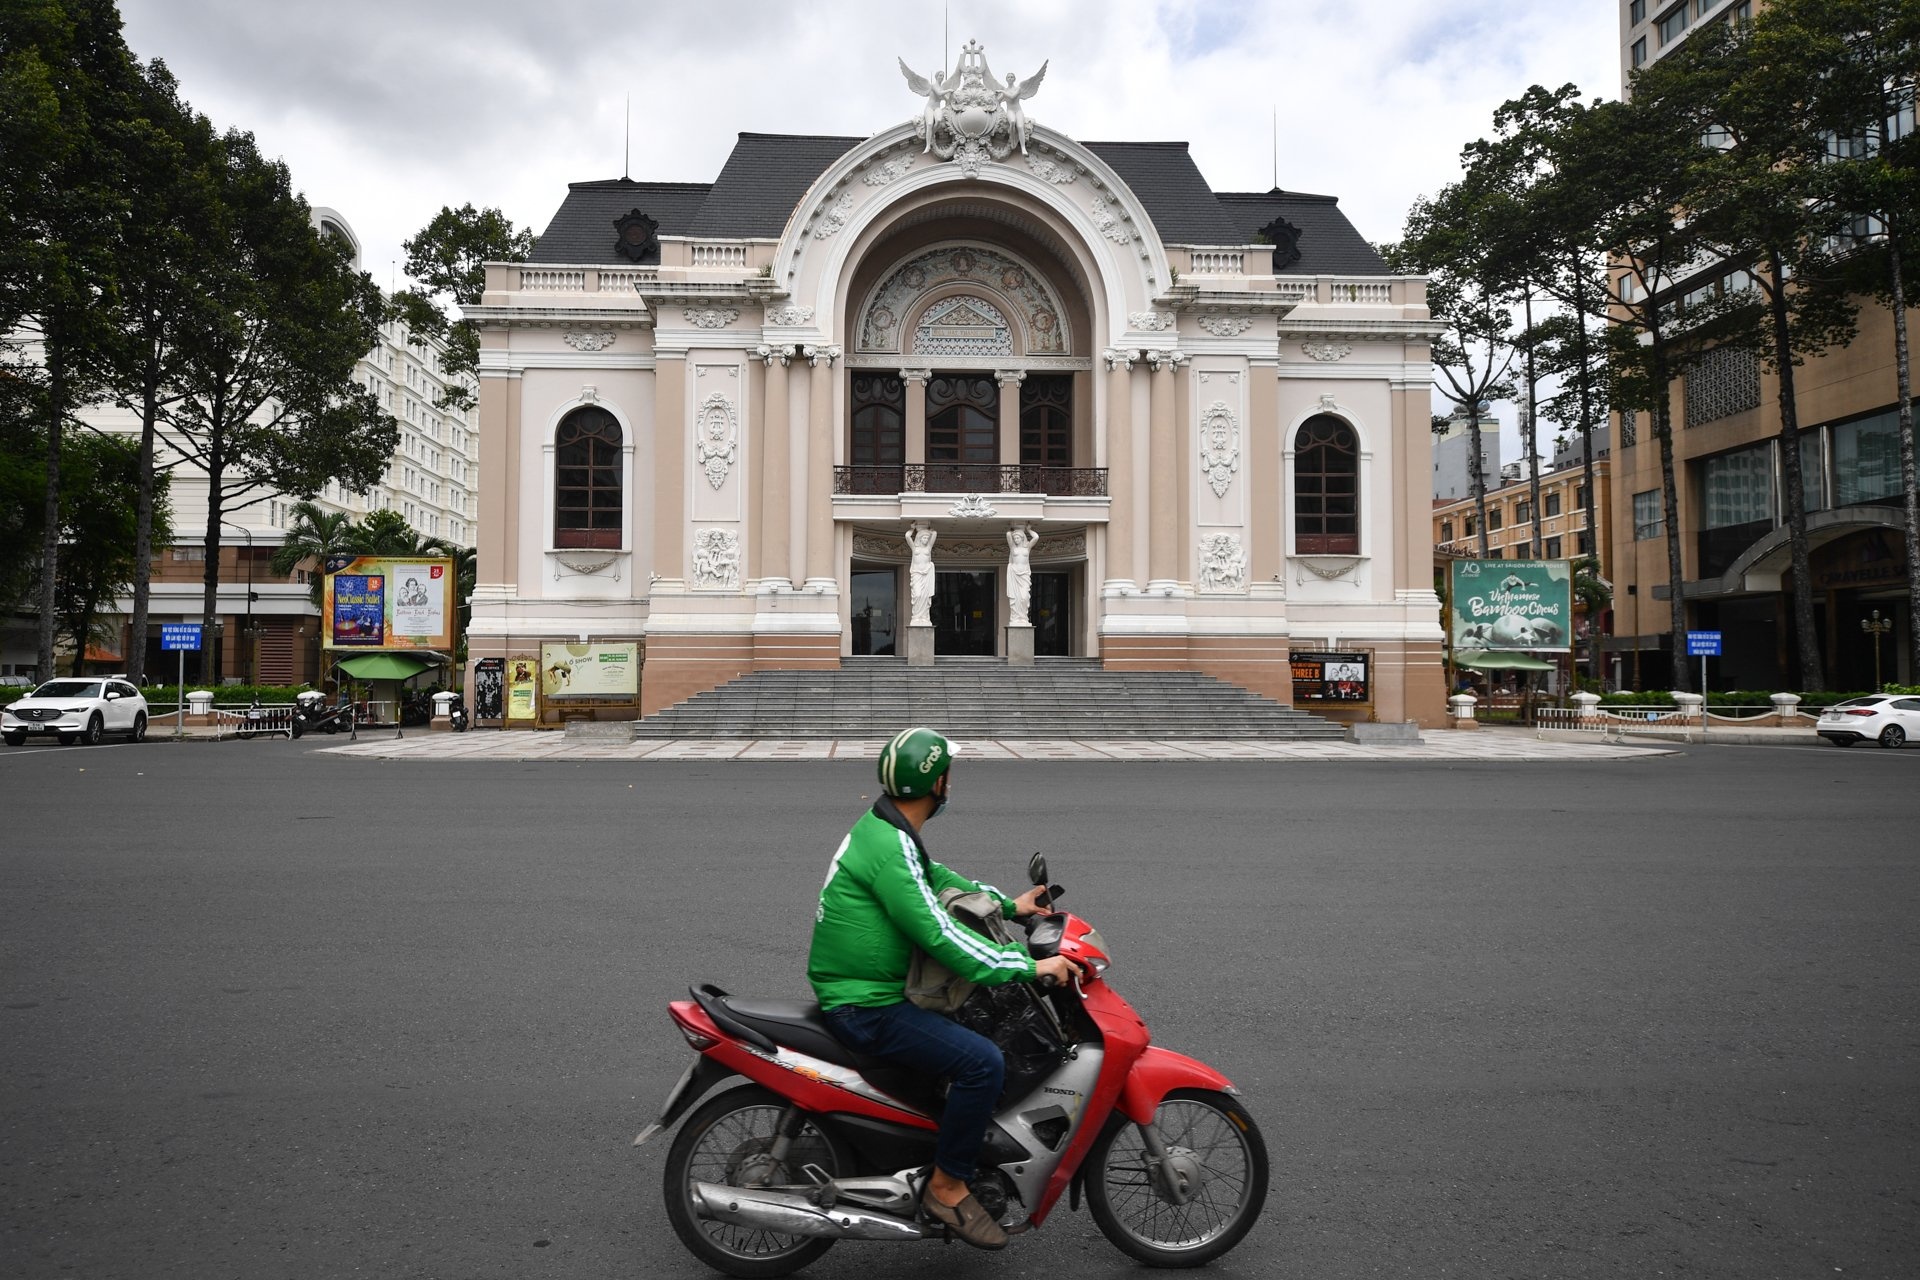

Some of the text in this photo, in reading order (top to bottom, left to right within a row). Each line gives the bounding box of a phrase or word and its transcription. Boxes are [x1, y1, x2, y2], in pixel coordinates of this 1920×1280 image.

[1488, 588, 1540, 604] Vietnamese
[1468, 596, 1527, 616] Bamboo
[1292, 668, 1314, 678] THREE
[919, 744, 942, 774] Grab
